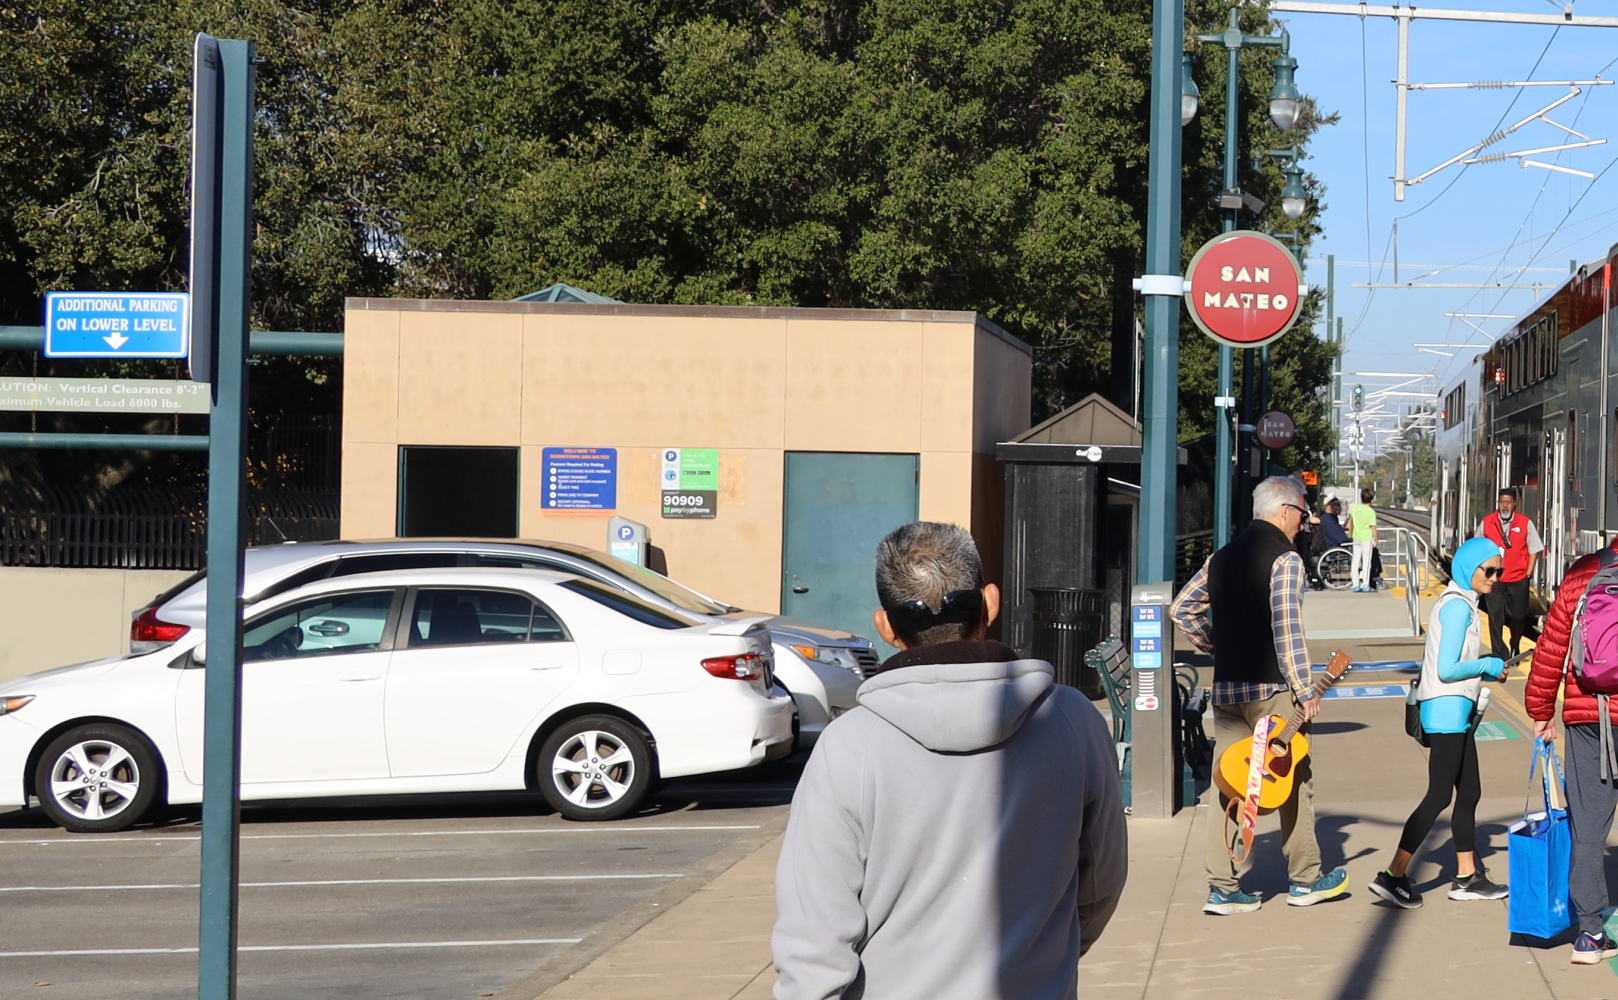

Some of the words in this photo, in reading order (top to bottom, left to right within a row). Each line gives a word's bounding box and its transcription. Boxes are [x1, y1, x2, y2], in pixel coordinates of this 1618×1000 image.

[1220, 266, 1270, 283] SAN
[58, 299, 125, 312] ADDITIONAL
[129, 300, 177, 312] PARKING
[1204, 292, 1289, 310] MATEO
[56, 318, 76, 331] ON
[82, 318, 129, 331] LOWER
[134, 319, 176, 332] LEVEL
[0, 382, 52, 392] UTION:
[60, 383, 107, 394] Vertical
[112, 384, 172, 395] Clearance
[47, 397, 90, 407] Vehicle
[95, 398, 125, 407] Load
[129, 399, 157, 408] 6000
[162, 399, 181, 408] lbs.
[664, 496, 703, 506] 90909
[622, 528, 631, 538] P
[1395, 886, 1410, 900] HOKA
